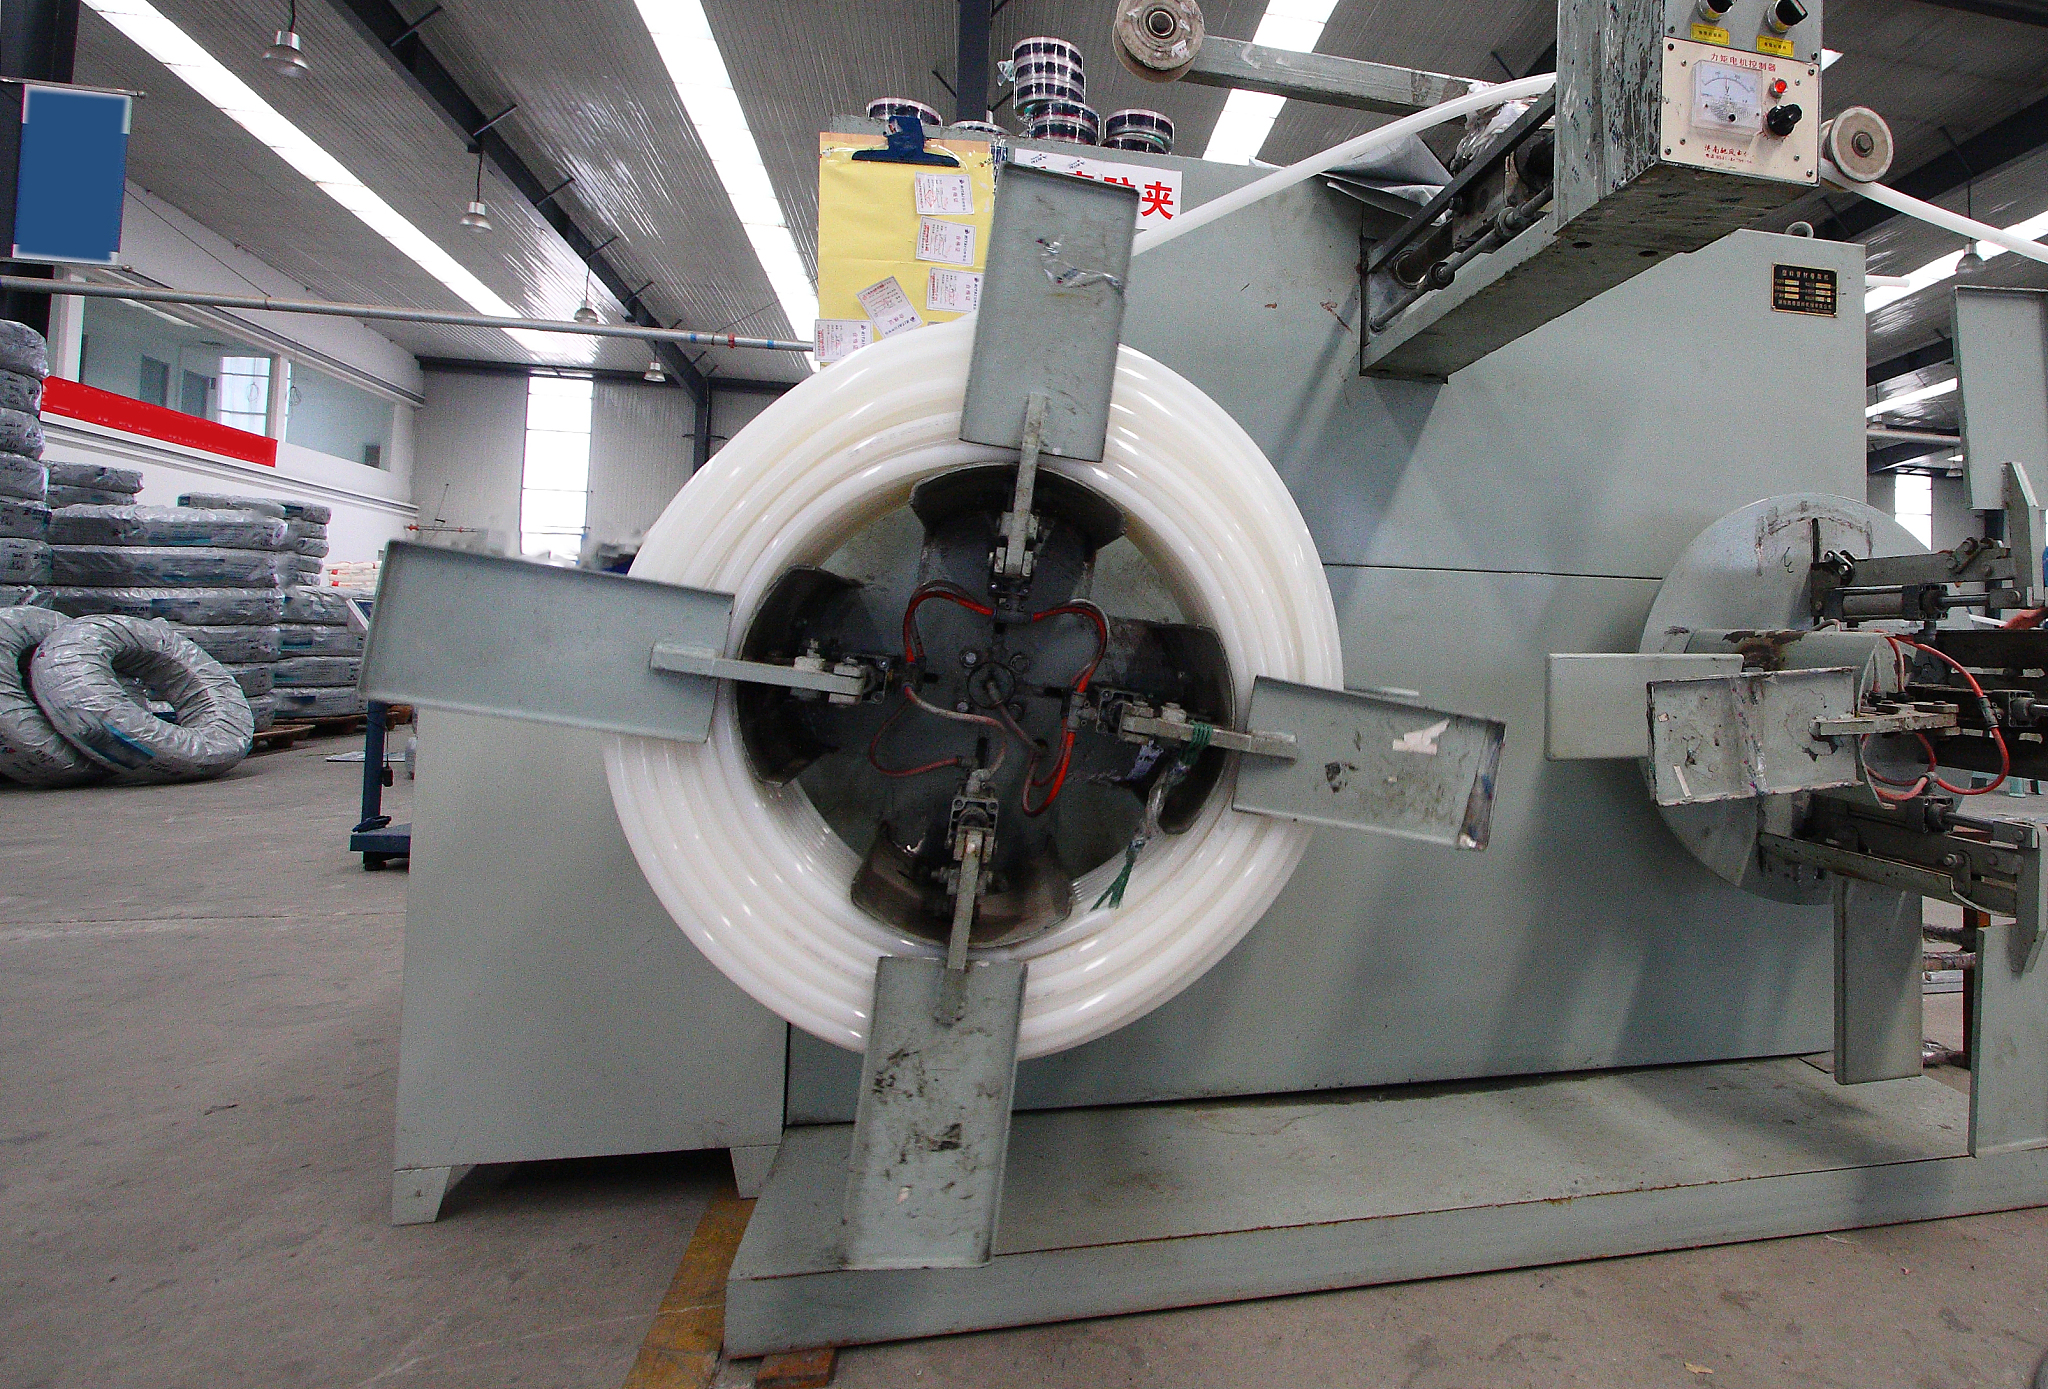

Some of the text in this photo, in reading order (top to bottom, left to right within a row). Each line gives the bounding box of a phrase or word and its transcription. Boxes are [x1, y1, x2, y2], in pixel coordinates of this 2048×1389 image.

[1711, 53, 1776, 72] 力矩电机控制器
